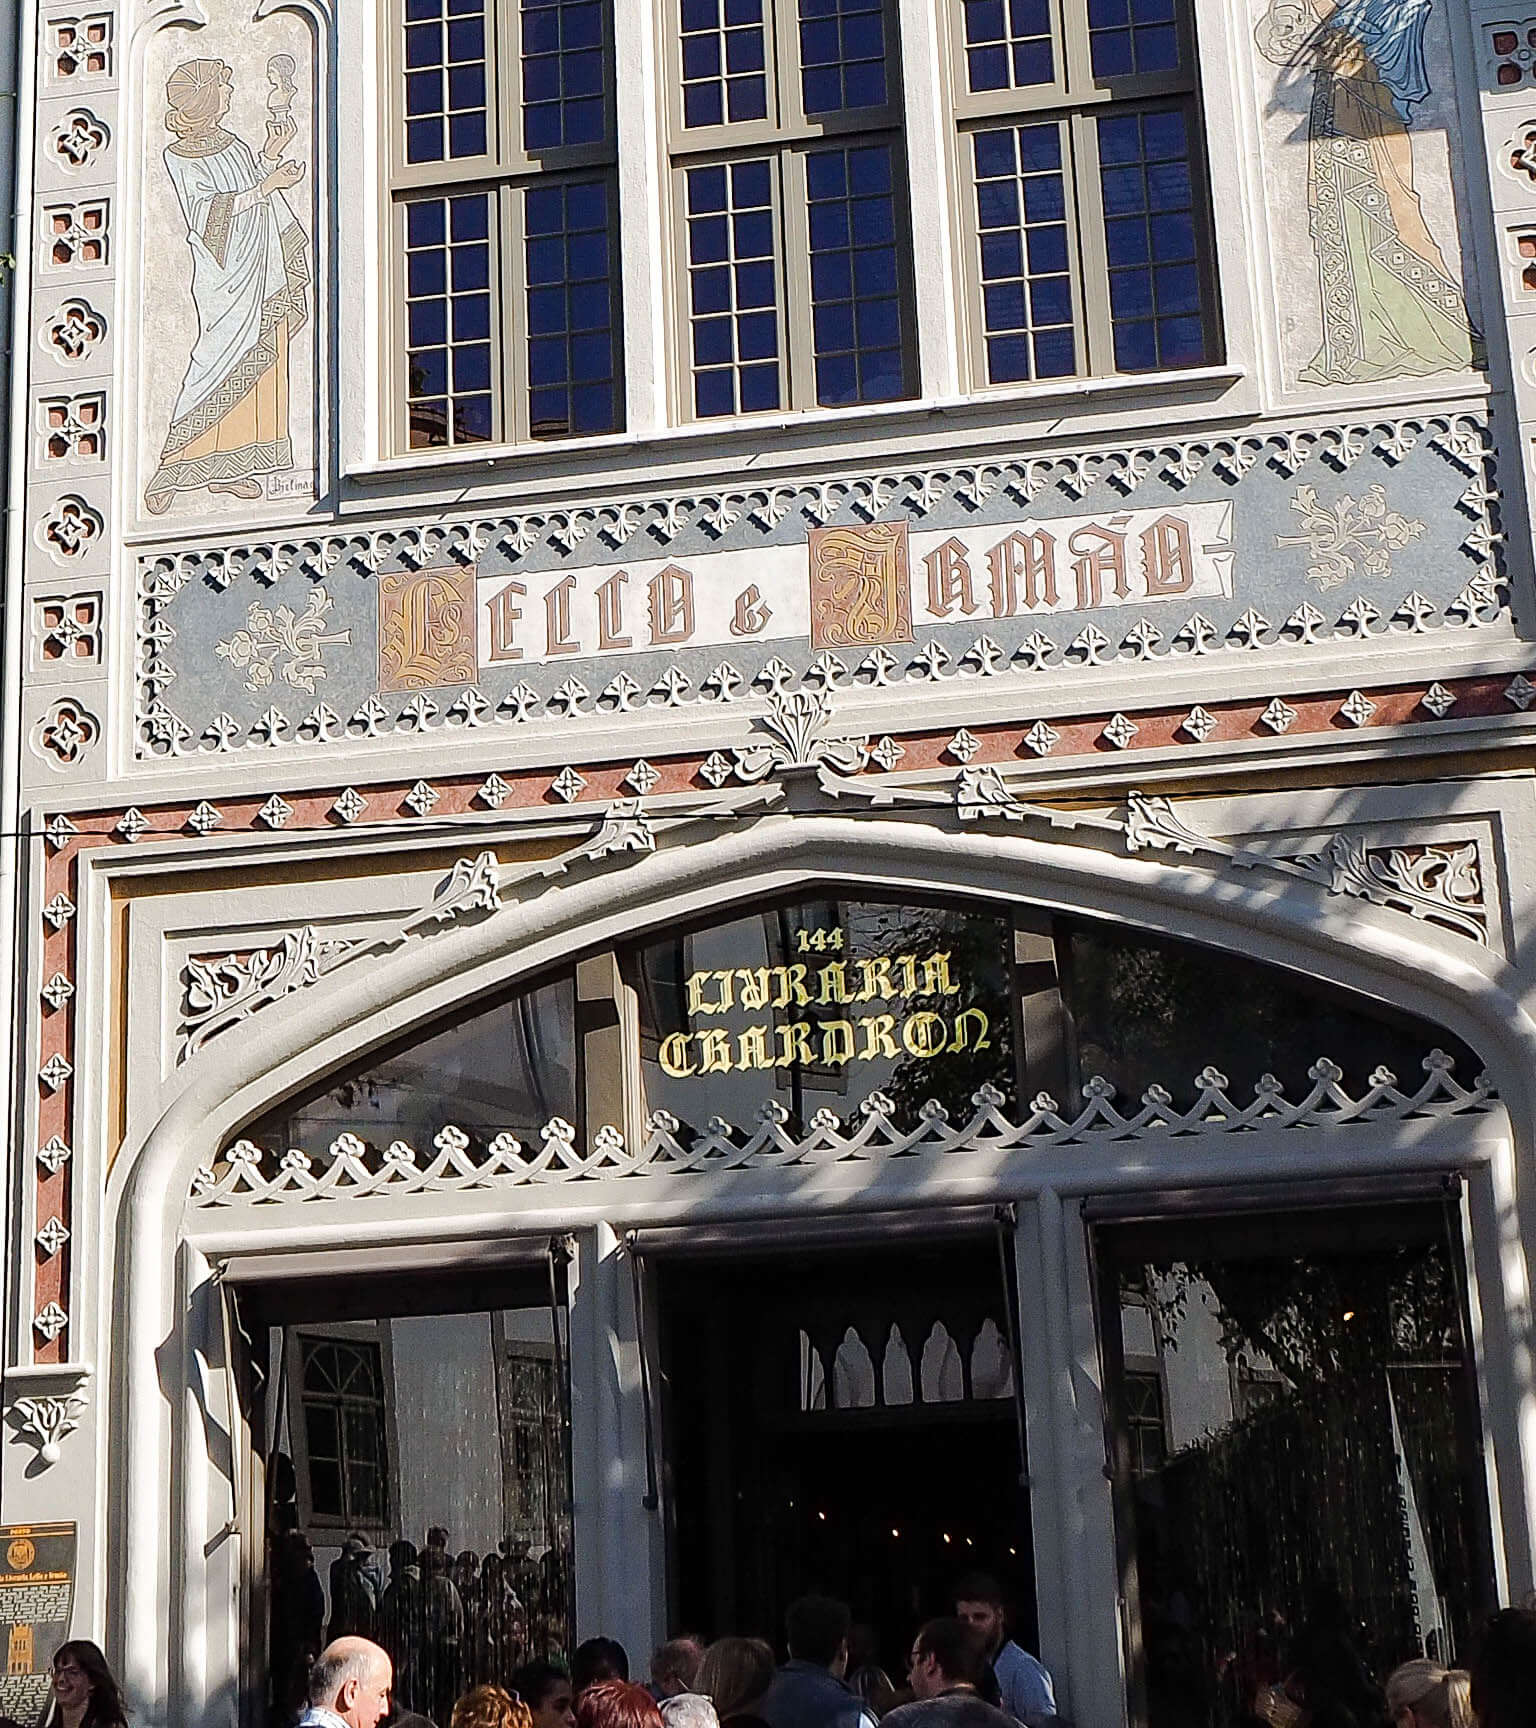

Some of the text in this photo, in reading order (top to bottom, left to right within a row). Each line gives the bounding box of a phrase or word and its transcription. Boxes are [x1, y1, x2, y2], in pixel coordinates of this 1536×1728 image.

[796, 927, 844, 953] 144
[684, 951, 961, 1017] LIVRARIA
[658, 1008, 992, 1078] CHARDRON
